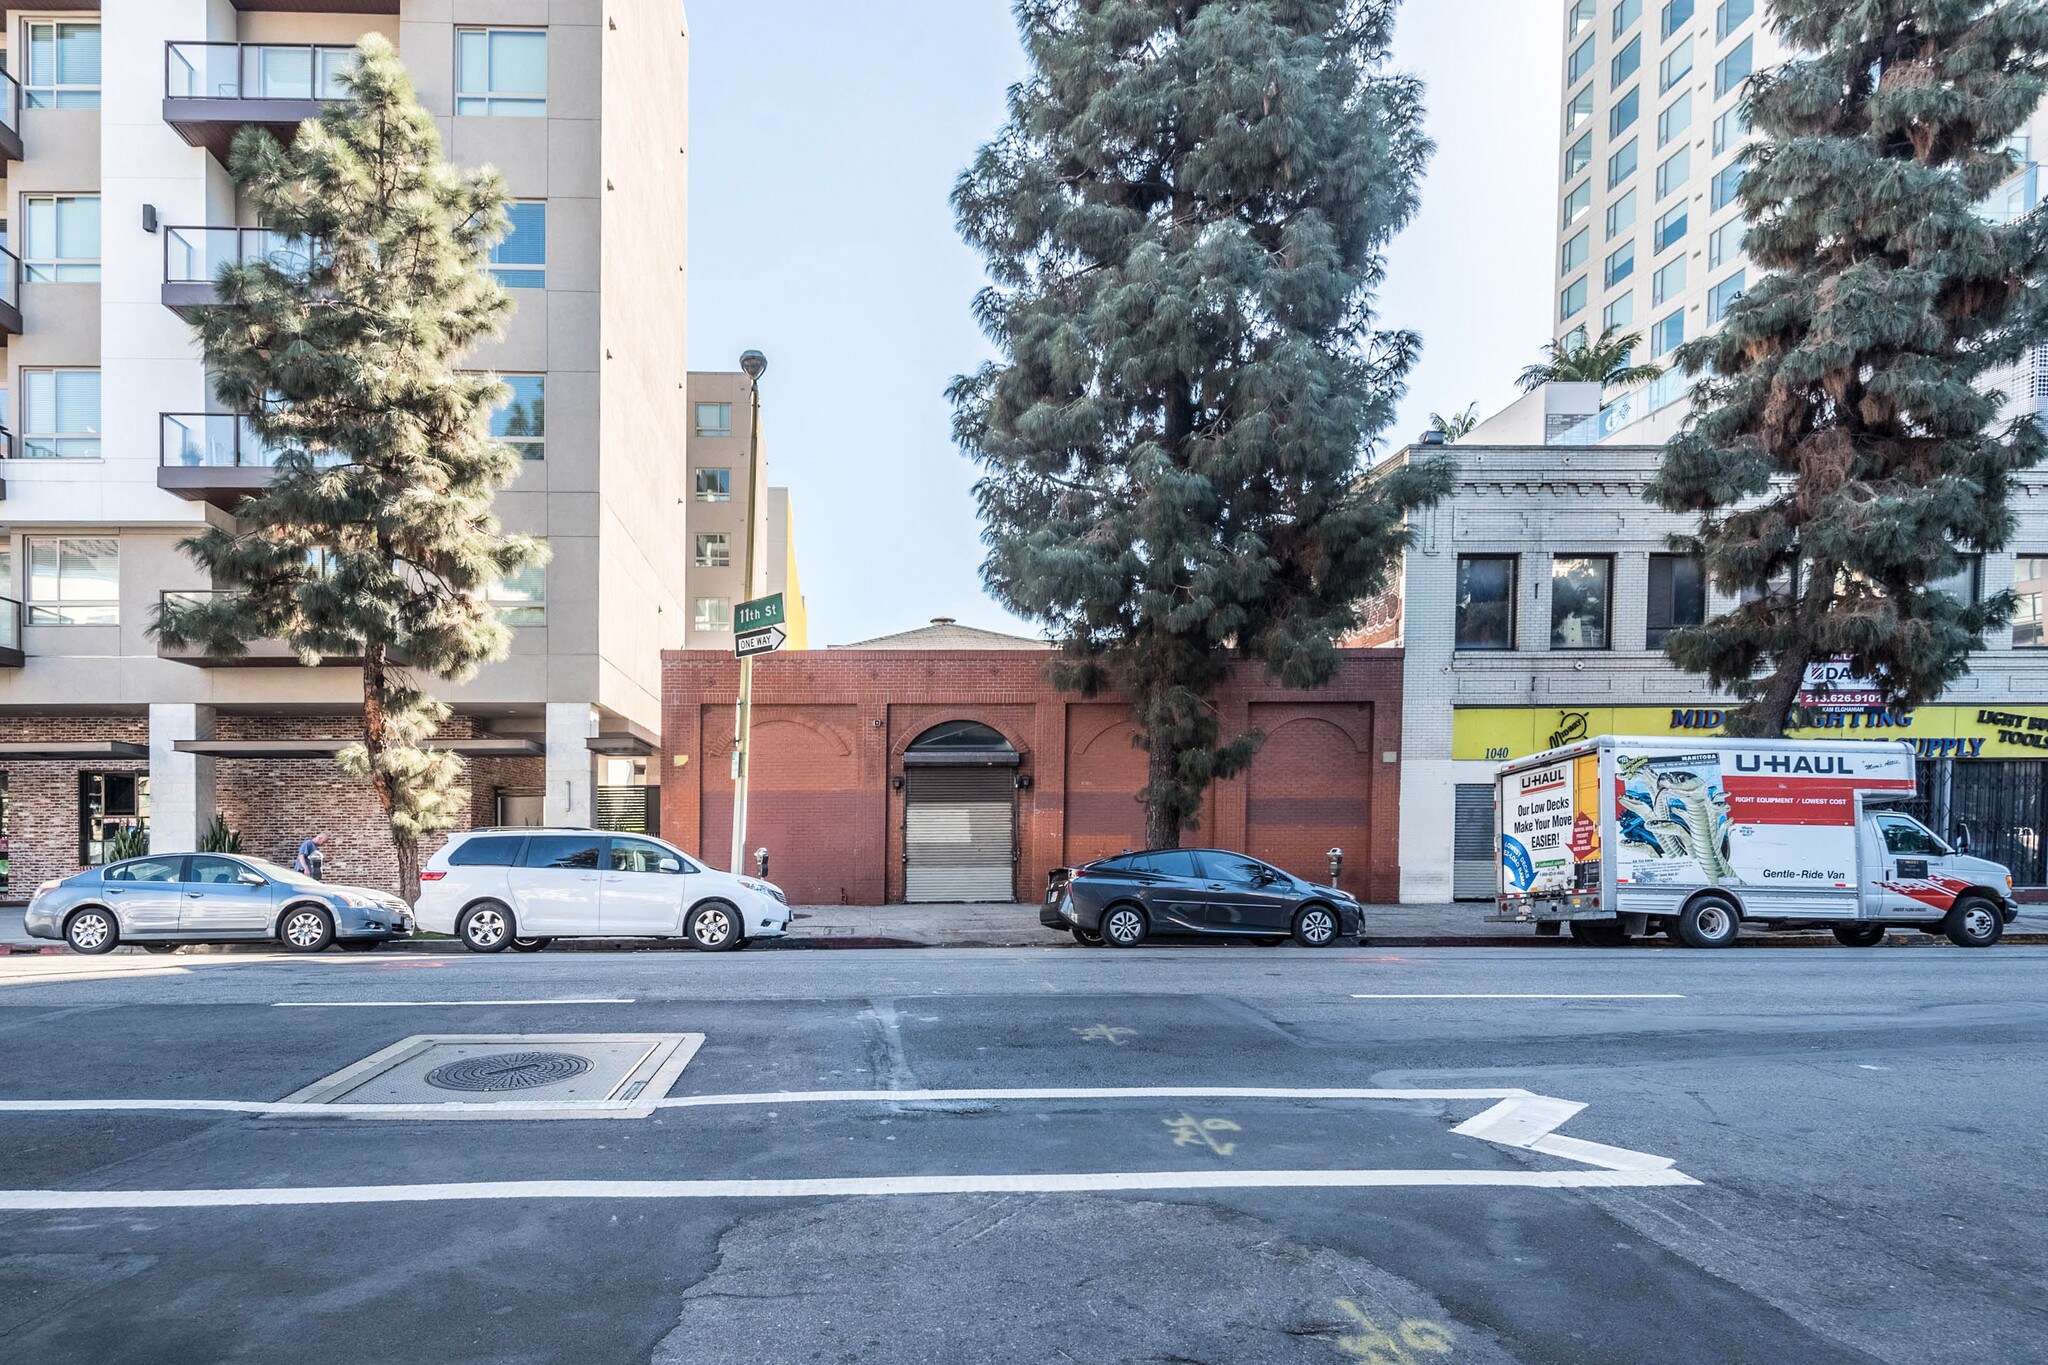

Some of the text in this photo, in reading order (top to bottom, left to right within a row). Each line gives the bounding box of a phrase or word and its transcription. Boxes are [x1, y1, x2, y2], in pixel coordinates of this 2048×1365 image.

[740, 604, 776, 623] 11th St
[741, 635, 771, 649] ONE WAY
[1670, 709, 1914, 729] MID GHTING
[1976, 709, 2028, 728] LIGHT
[1485, 747, 1509, 759] 1040
[1896, 737, 1987, 757] UPPLY
[1735, 754, 1854, 775] U-HAUL
[1521, 769, 1565, 788] U-HAUL
[1517, 796, 1570, 817] Our Low Decks
[1756, 796, 1794, 804] EQUIPMENT
[1801, 797, 1828, 805] LOWEST
[1514, 820, 1534, 834] Make
[1534, 818, 1550, 831] Your
[1552, 815, 1573, 828] Move
[1531, 832, 1560, 848] EASIER!
[1762, 868, 1845, 879] Gentle-Ride Van
